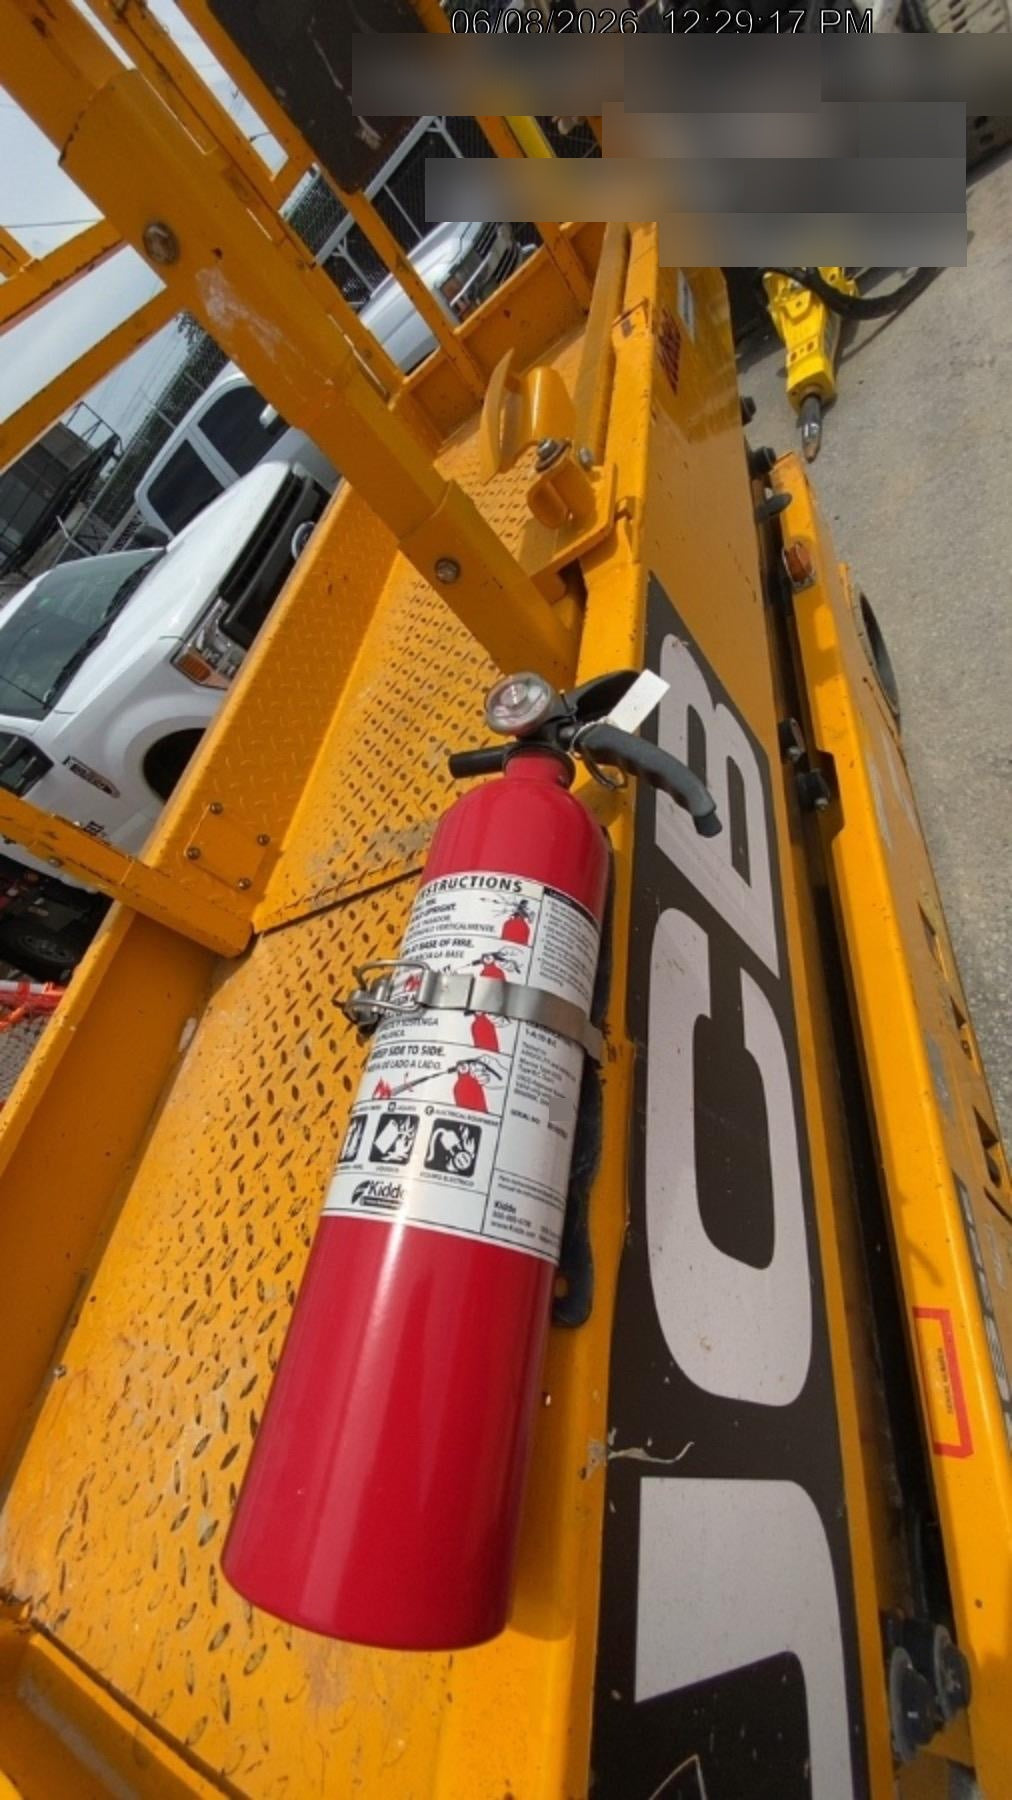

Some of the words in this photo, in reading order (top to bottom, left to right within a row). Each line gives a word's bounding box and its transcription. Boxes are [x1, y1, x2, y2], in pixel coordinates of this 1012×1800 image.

[417, 875, 523, 898] NSTRUCTIONS
[408, 1045, 420, 1055] TO
[422, 1045, 446, 1057] SIDE.
[634, 632, 856, 1800] JCB
